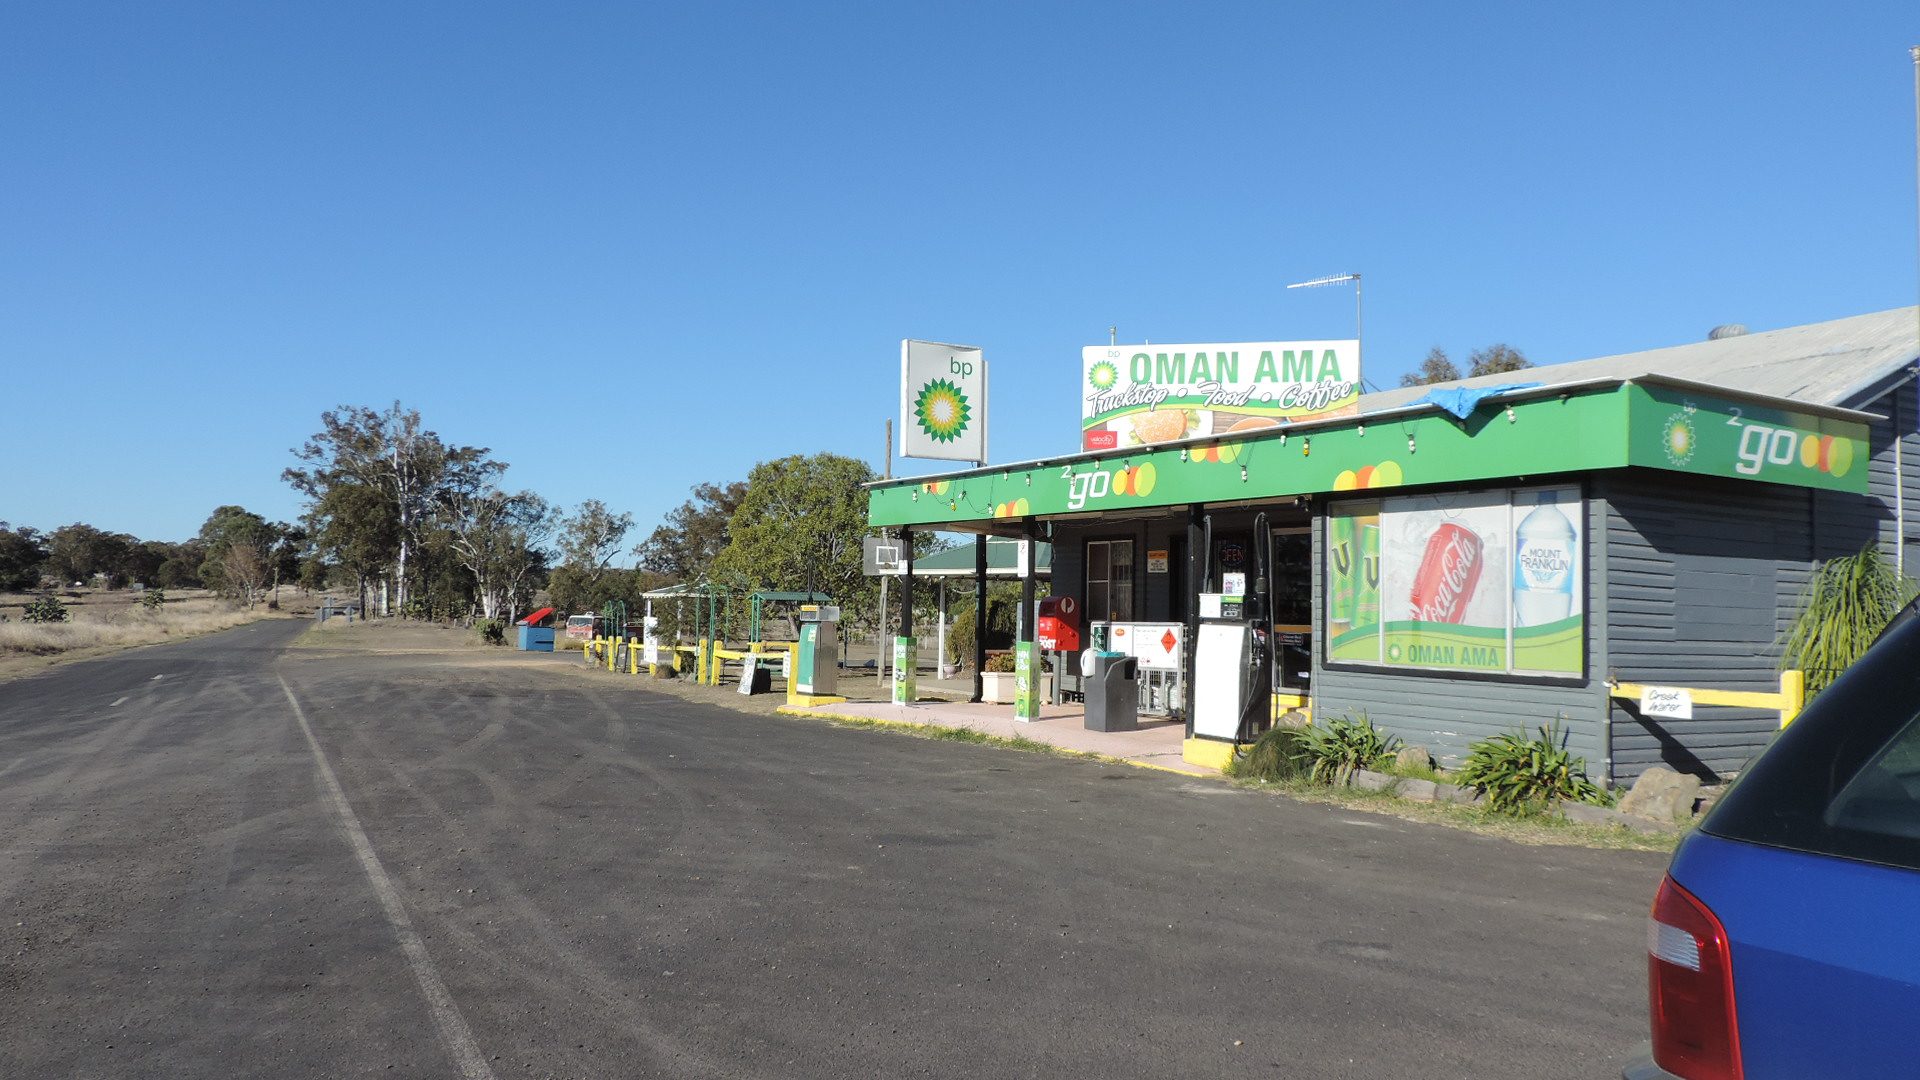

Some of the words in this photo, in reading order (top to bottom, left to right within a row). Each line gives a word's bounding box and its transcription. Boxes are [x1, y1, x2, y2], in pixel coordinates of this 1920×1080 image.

[950, 356, 973, 379] bp
[1129, 351, 1239, 385] OMAN
[1253, 349, 1342, 383] AMA
[1086, 382, 1168, 419] Truckstop
[1197, 381, 1256, 407] Food
[1278, 380, 1351, 411] Coffee
[1726, 407, 1743, 426] 2
[1735, 424, 1798, 475] go
[1060, 465, 1073, 478] 2
[1068, 470, 1111, 510] go
[1520, 554, 1569, 571] FRANKLIN
[1529, 548, 1562, 559] MOUNT
[1408, 645, 1455, 664] OMAN
[1461, 646, 1499, 667] AMA
